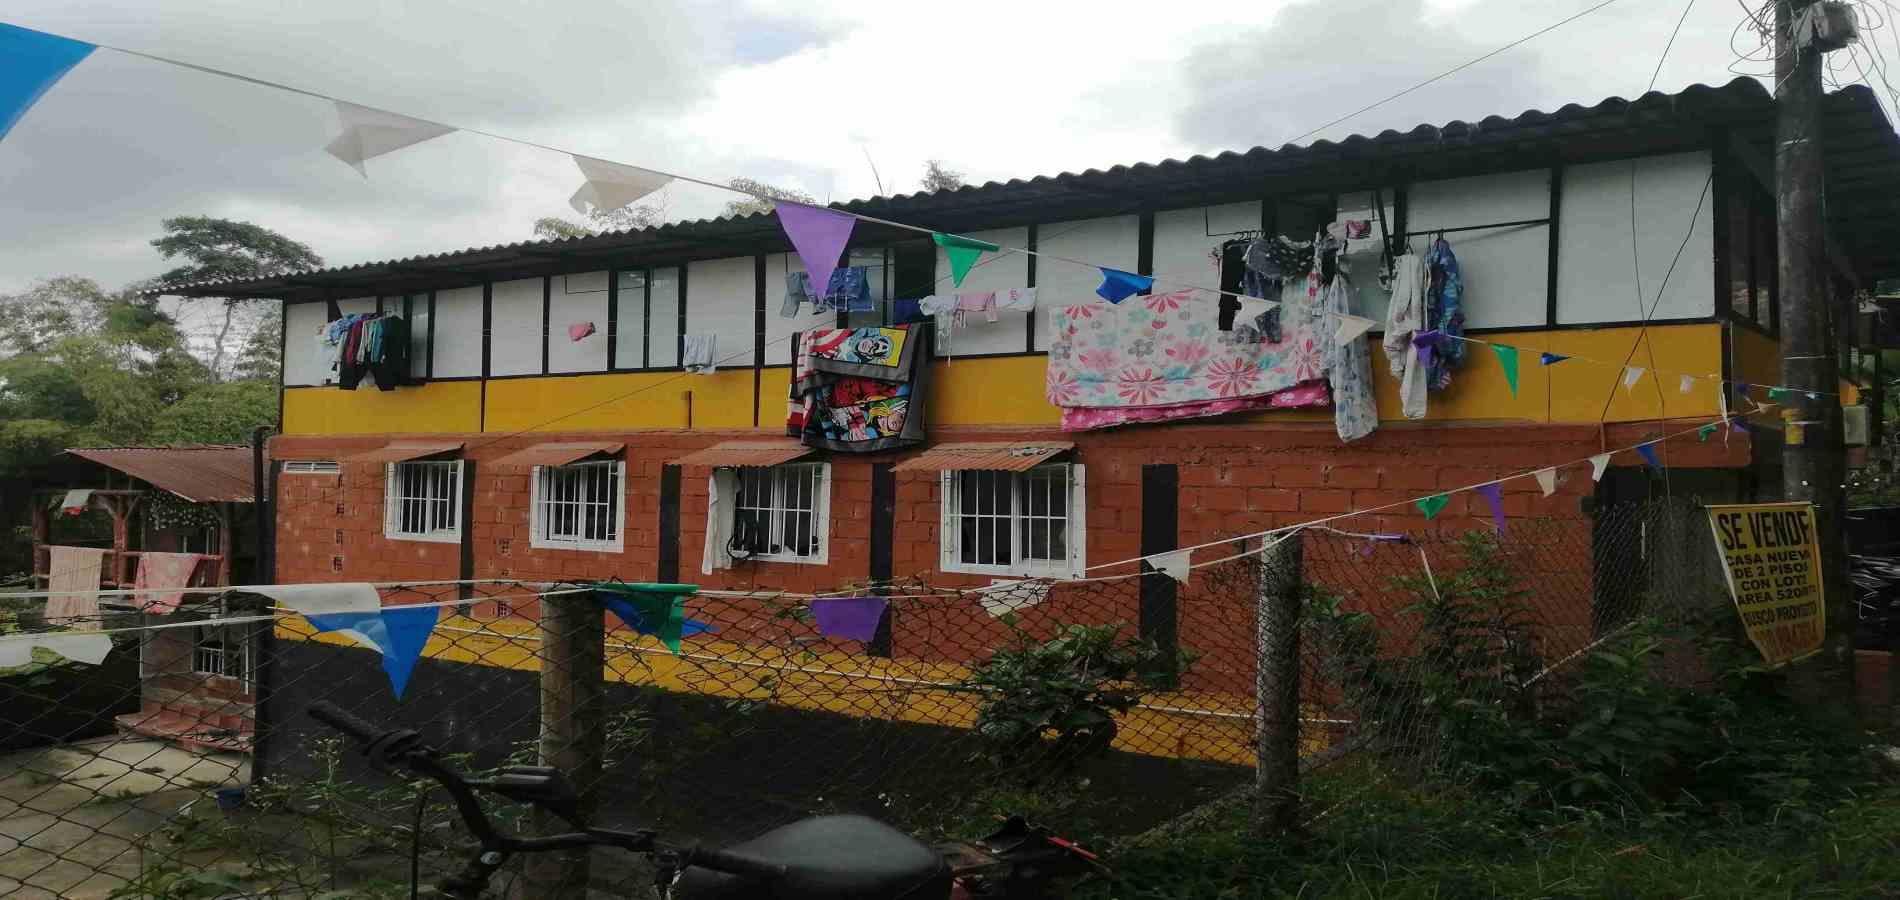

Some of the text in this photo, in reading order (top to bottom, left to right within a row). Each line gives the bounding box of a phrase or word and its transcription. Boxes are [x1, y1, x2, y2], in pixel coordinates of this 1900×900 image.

[1718, 513, 1747, 550] SE
[1726, 554, 1763, 567] CASA
[1734, 567, 1753, 579] DE
[1757, 566, 1765, 577] 2
[1741, 579, 1771, 591] CON
[1737, 592, 1774, 605] AREA
